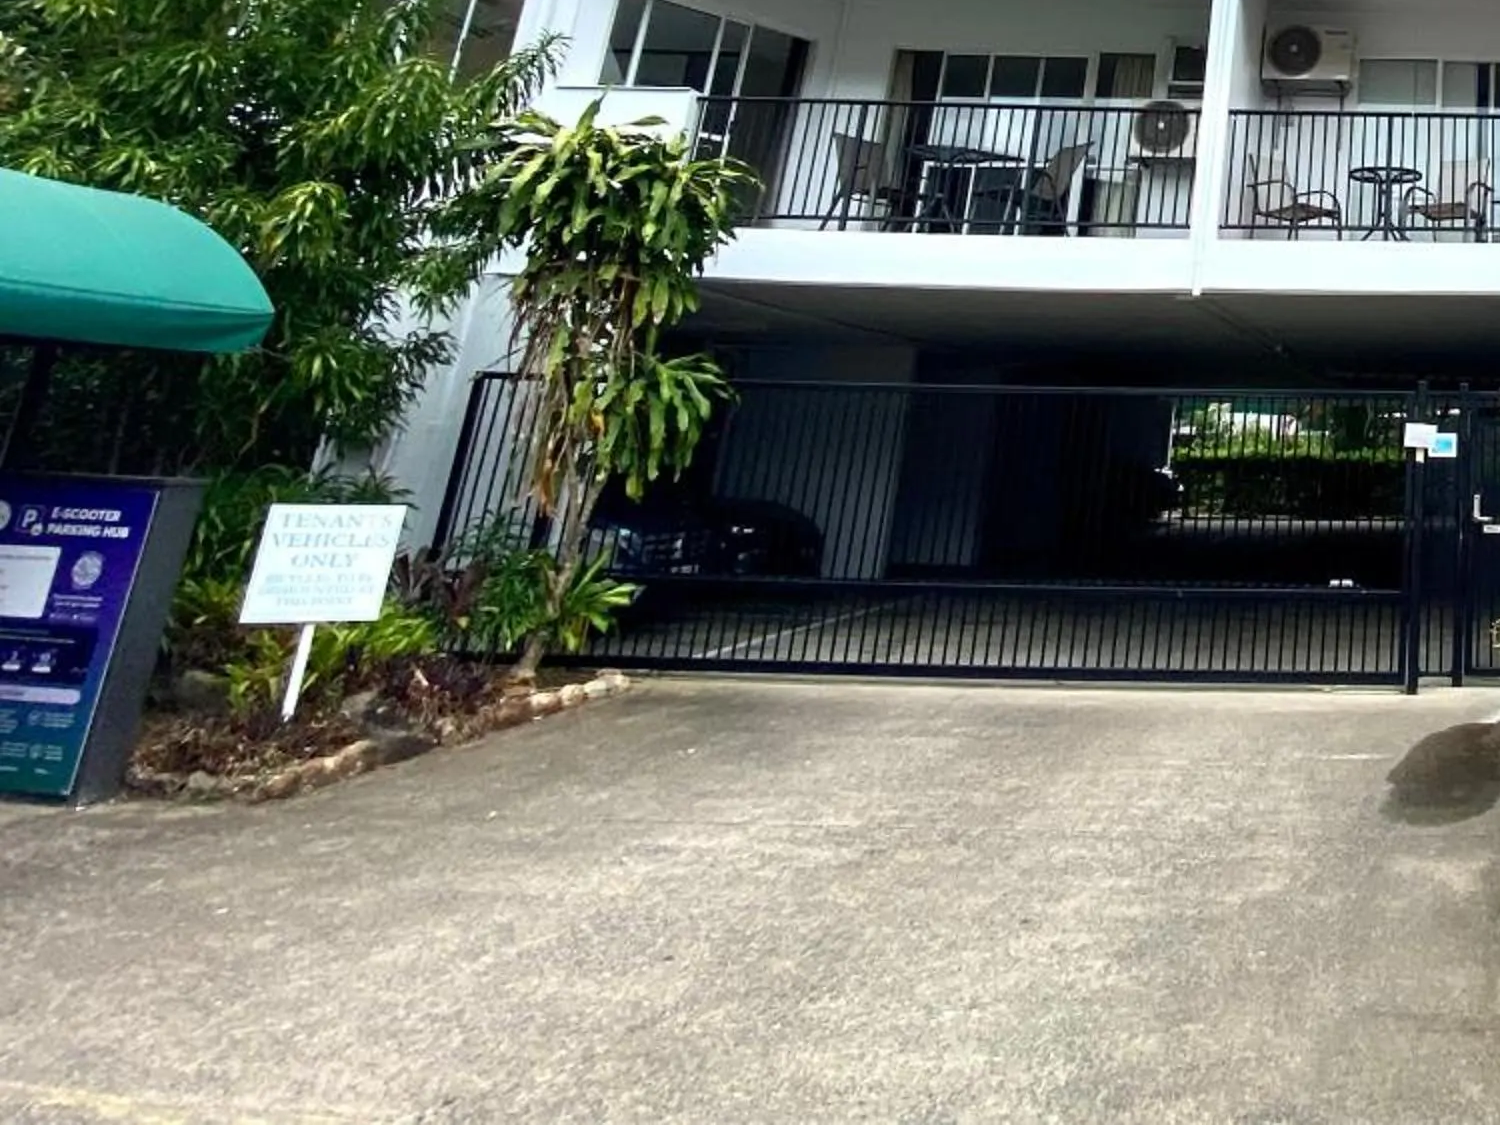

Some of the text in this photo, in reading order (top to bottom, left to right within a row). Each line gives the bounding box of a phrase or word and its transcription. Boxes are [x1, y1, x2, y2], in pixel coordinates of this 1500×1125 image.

[51, 507, 121, 522] E-SCOOTER
[280, 512, 393, 528] TENANTS
[47, 523, 101, 537] PARKING
[273, 532, 391, 549] VEHICLES
[291, 552, 360, 569] ONLY
